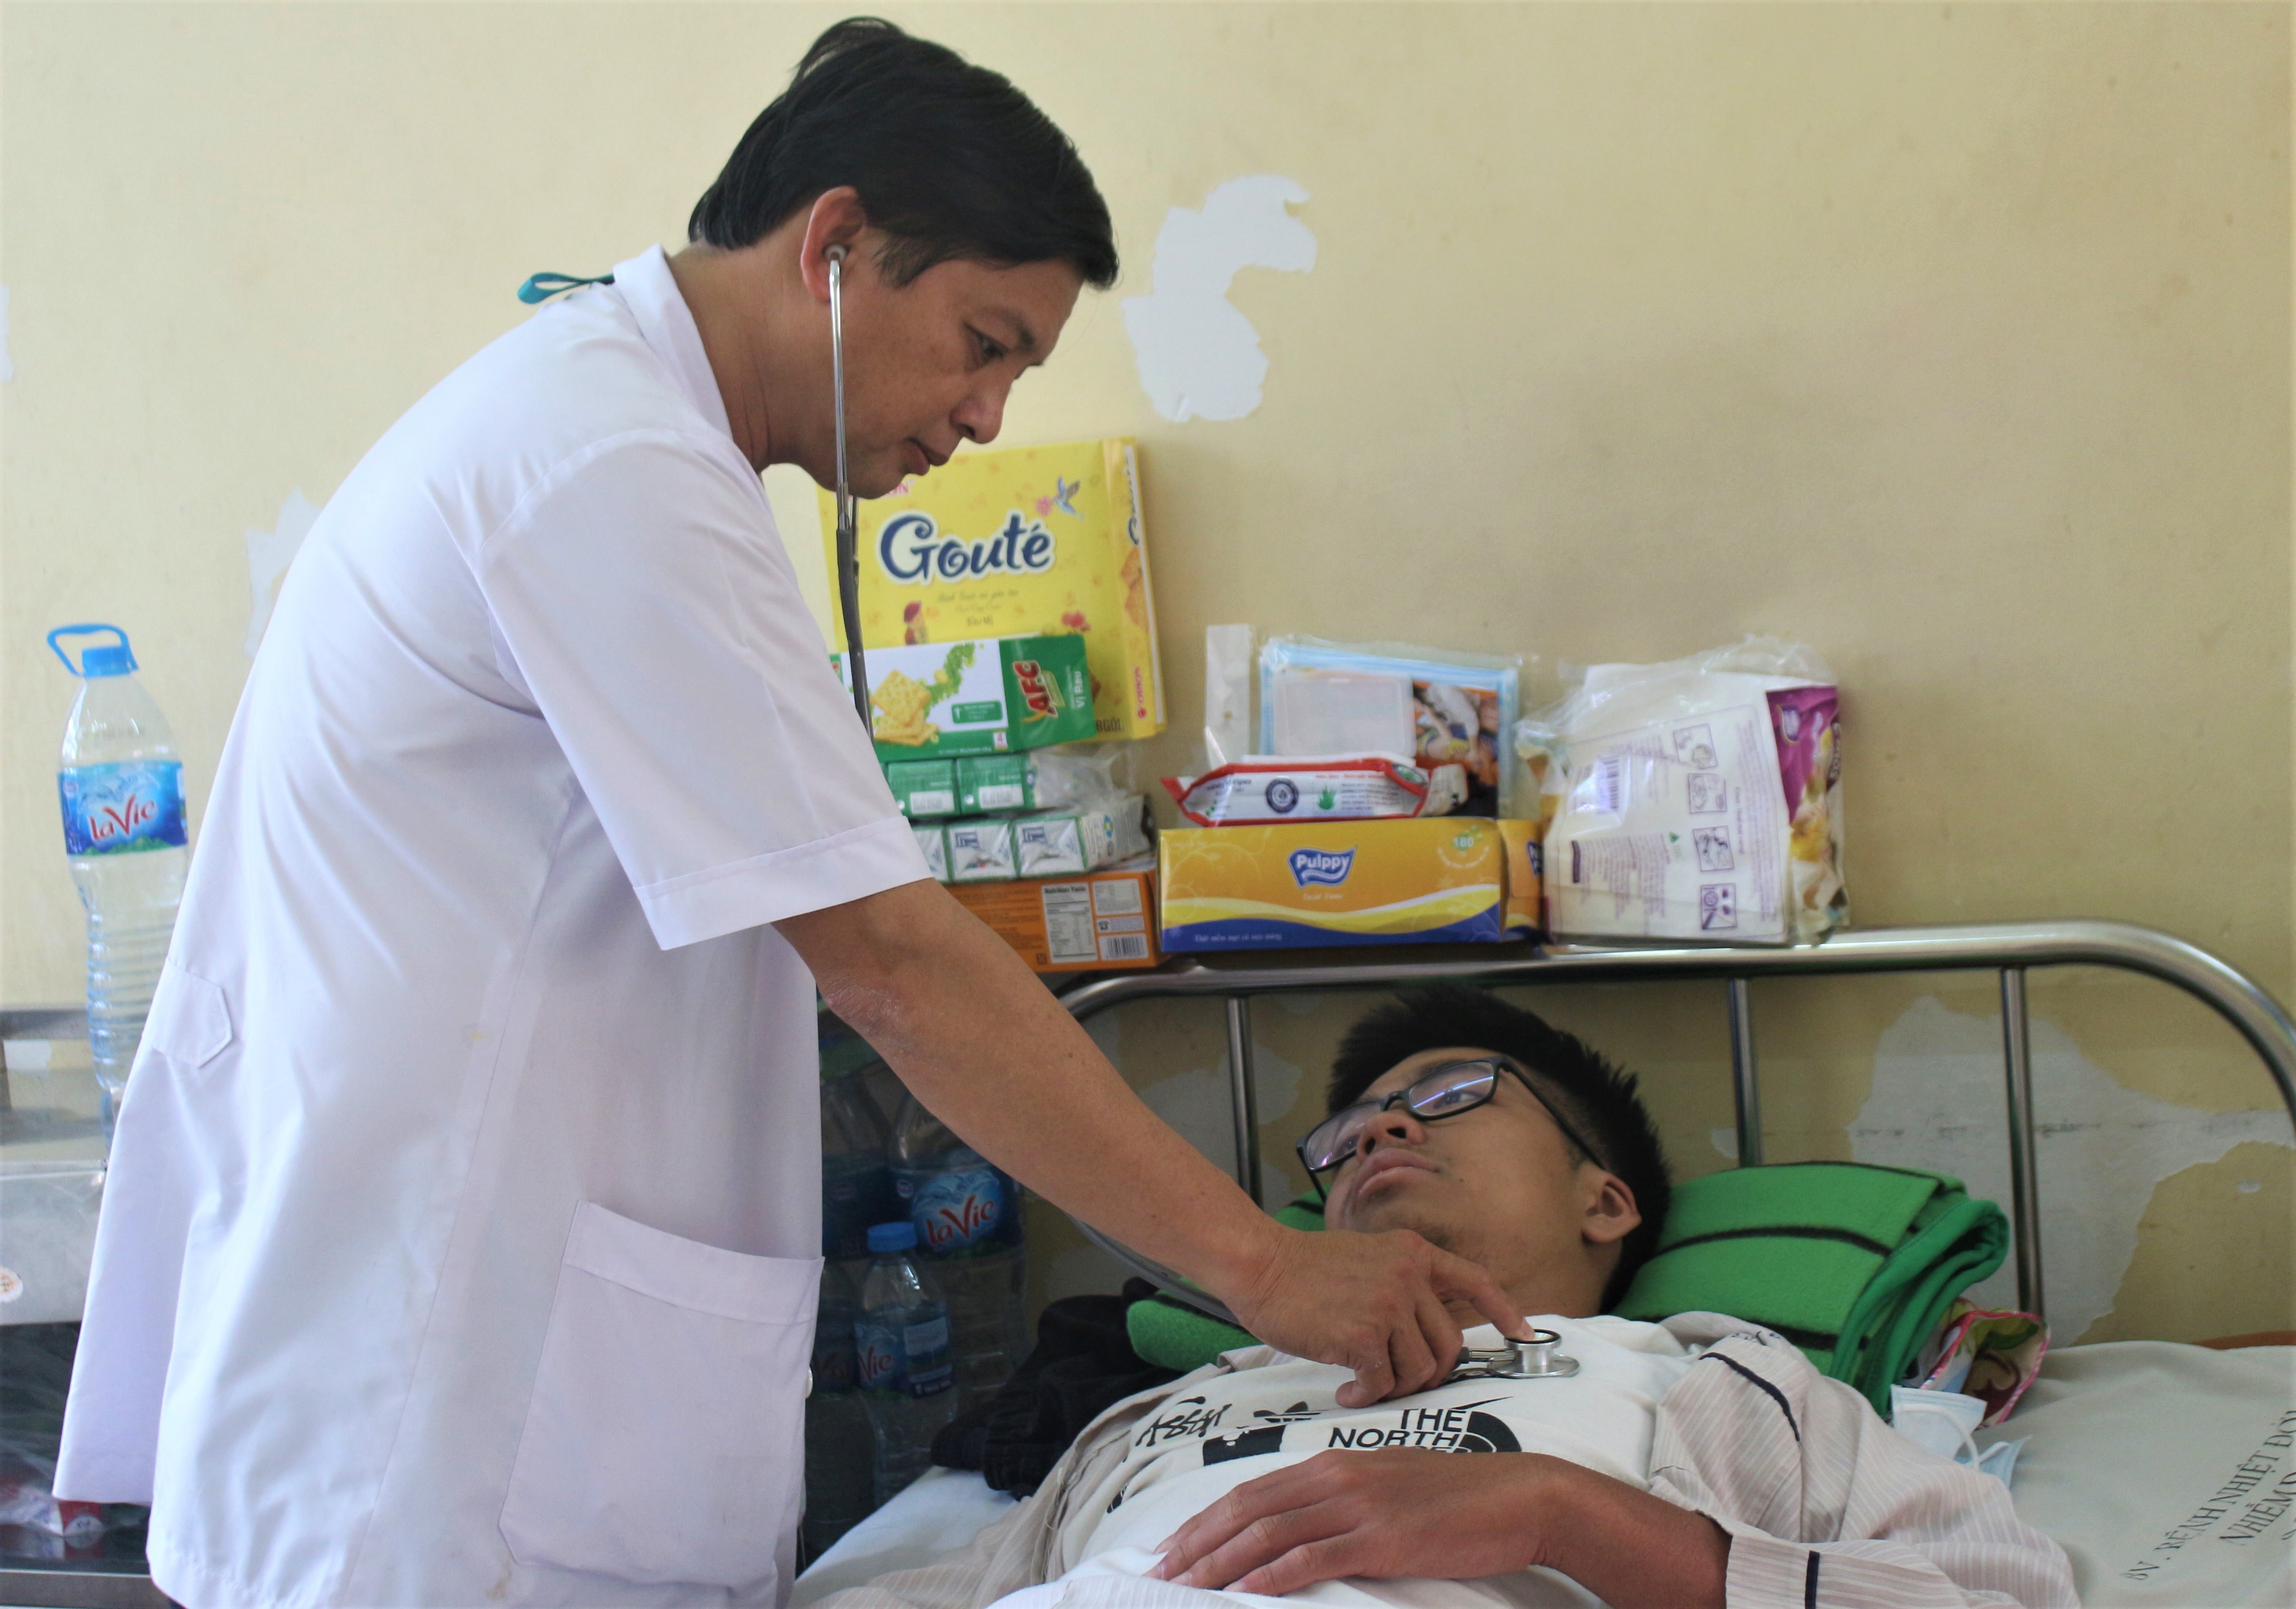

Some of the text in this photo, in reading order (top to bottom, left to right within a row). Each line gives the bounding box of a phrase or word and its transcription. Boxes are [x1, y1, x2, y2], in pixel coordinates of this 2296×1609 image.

[880, 513, 1050, 580] Gouté
[1012, 660, 1059, 718] AFC
[1296, 853, 1351, 874] Pulppy
[1401, 1408, 1467, 1432] THE
[1328, 1427, 1459, 1448] NORTH
